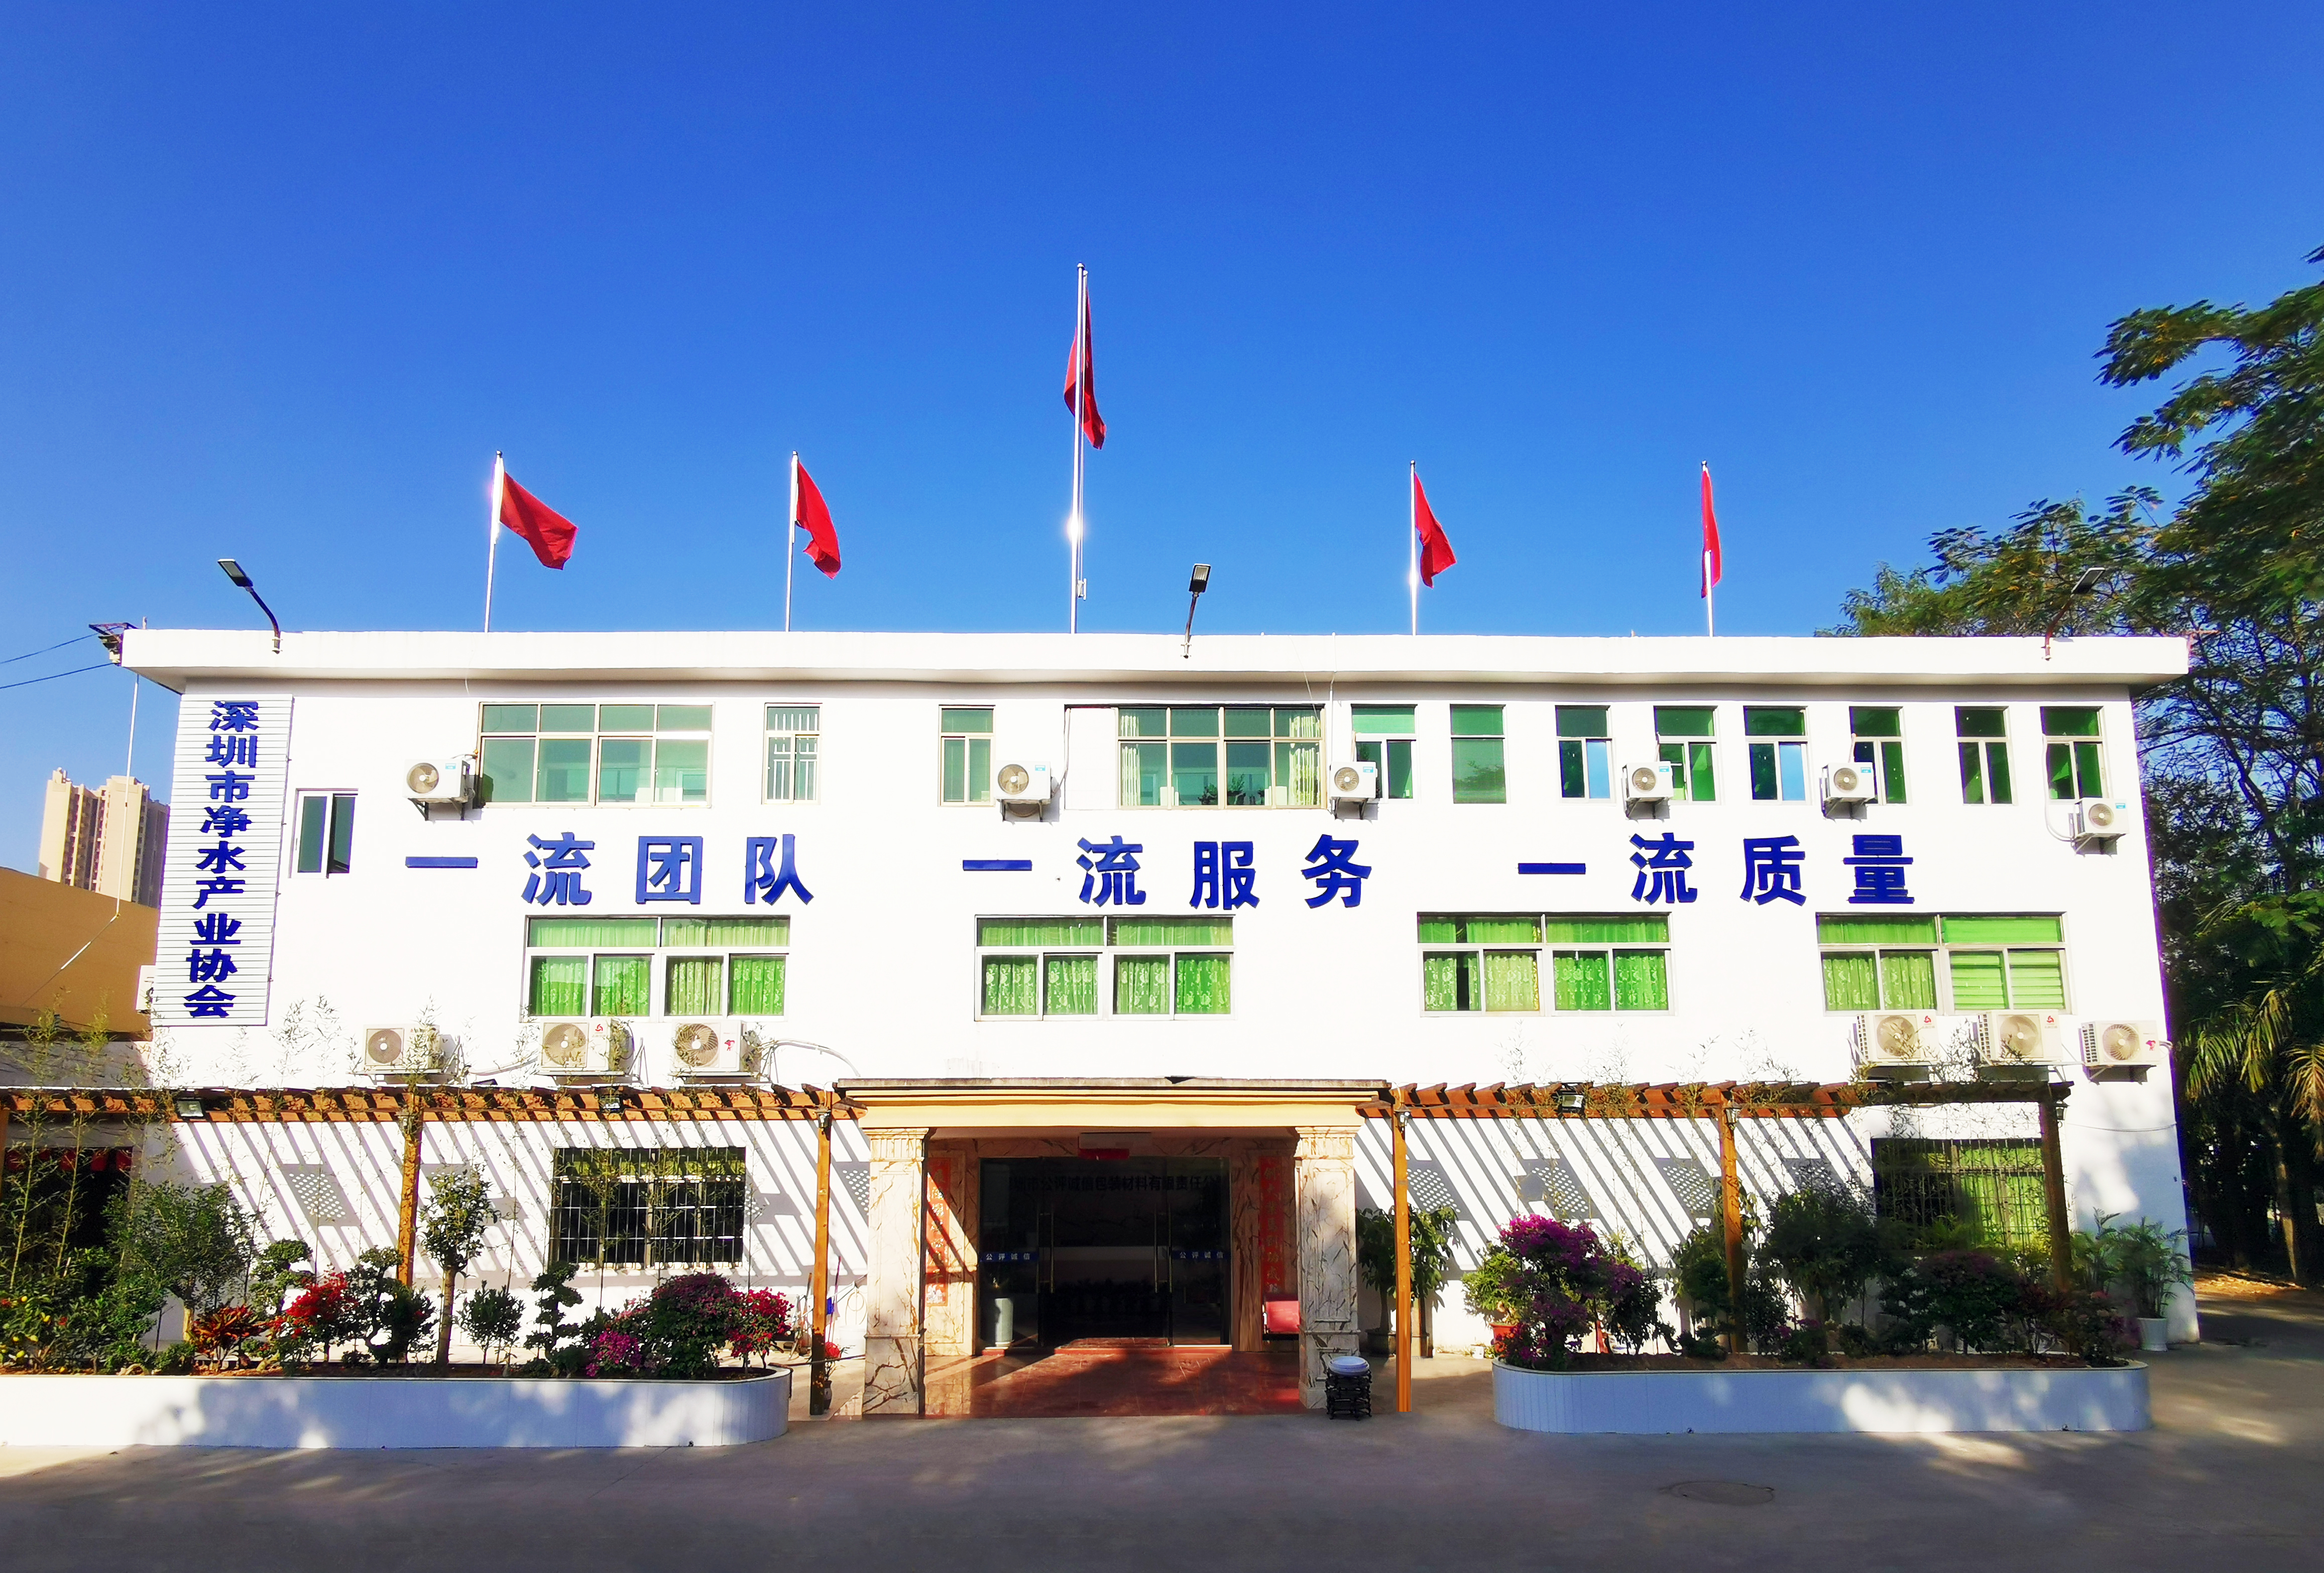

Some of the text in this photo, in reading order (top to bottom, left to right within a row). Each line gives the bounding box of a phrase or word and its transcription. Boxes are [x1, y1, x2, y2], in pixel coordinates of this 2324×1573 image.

[184, 701, 259, 1019] 深圳市净水产业协会
[405, 832, 1915, 910] 一流团队 一流服务 一流质量
